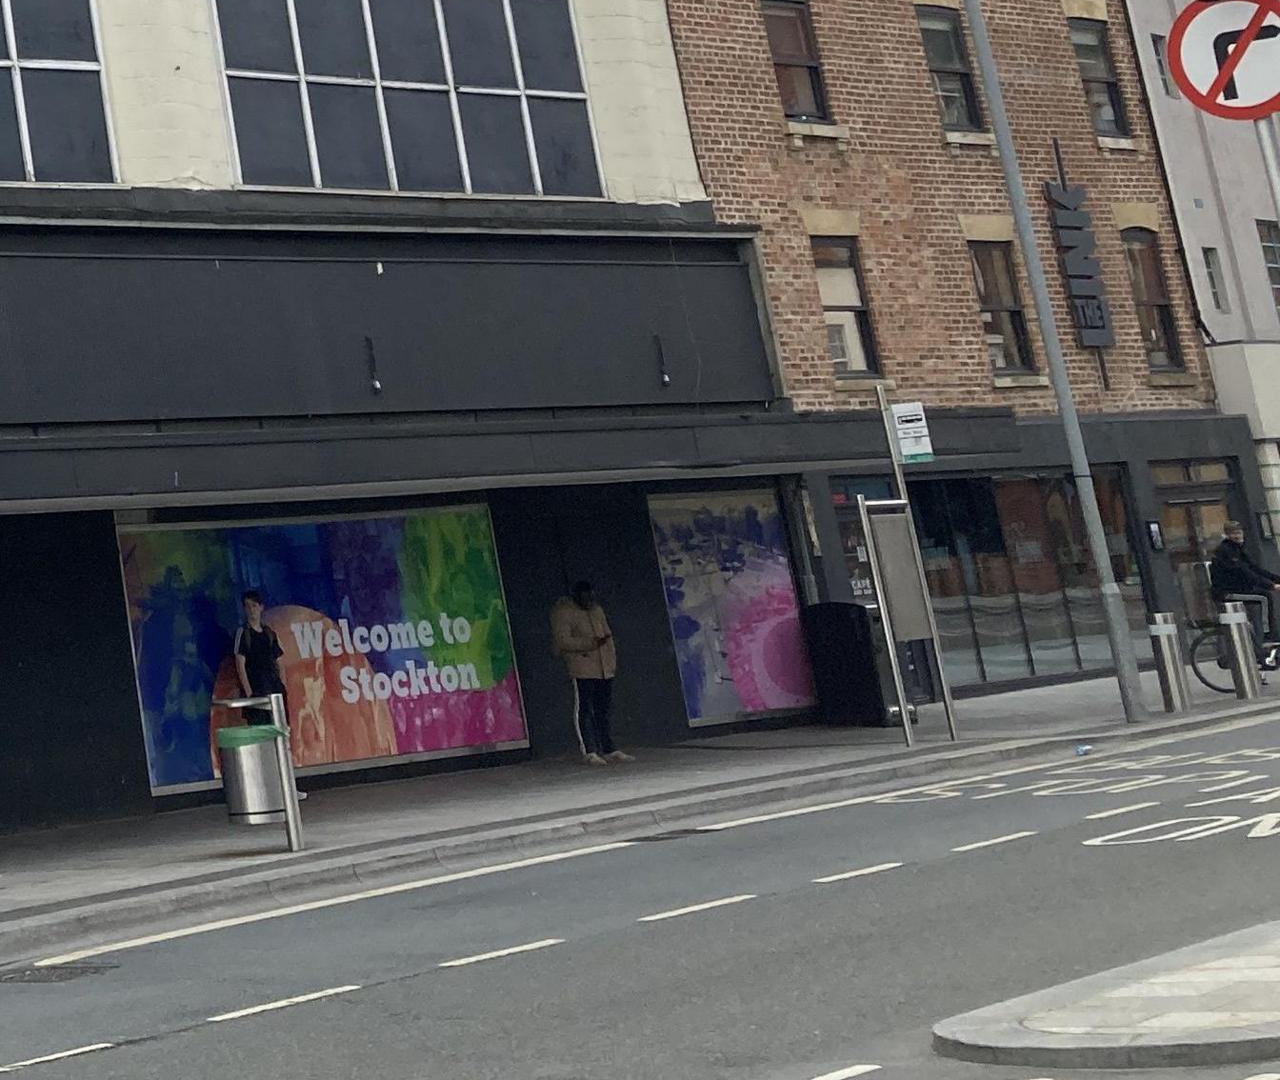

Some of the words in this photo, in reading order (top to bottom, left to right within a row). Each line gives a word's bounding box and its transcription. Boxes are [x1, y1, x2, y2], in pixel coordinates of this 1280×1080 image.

[291, 618, 434, 659] Welcome
[439, 612, 472, 644] to
[340, 660, 481, 704] Stockton
